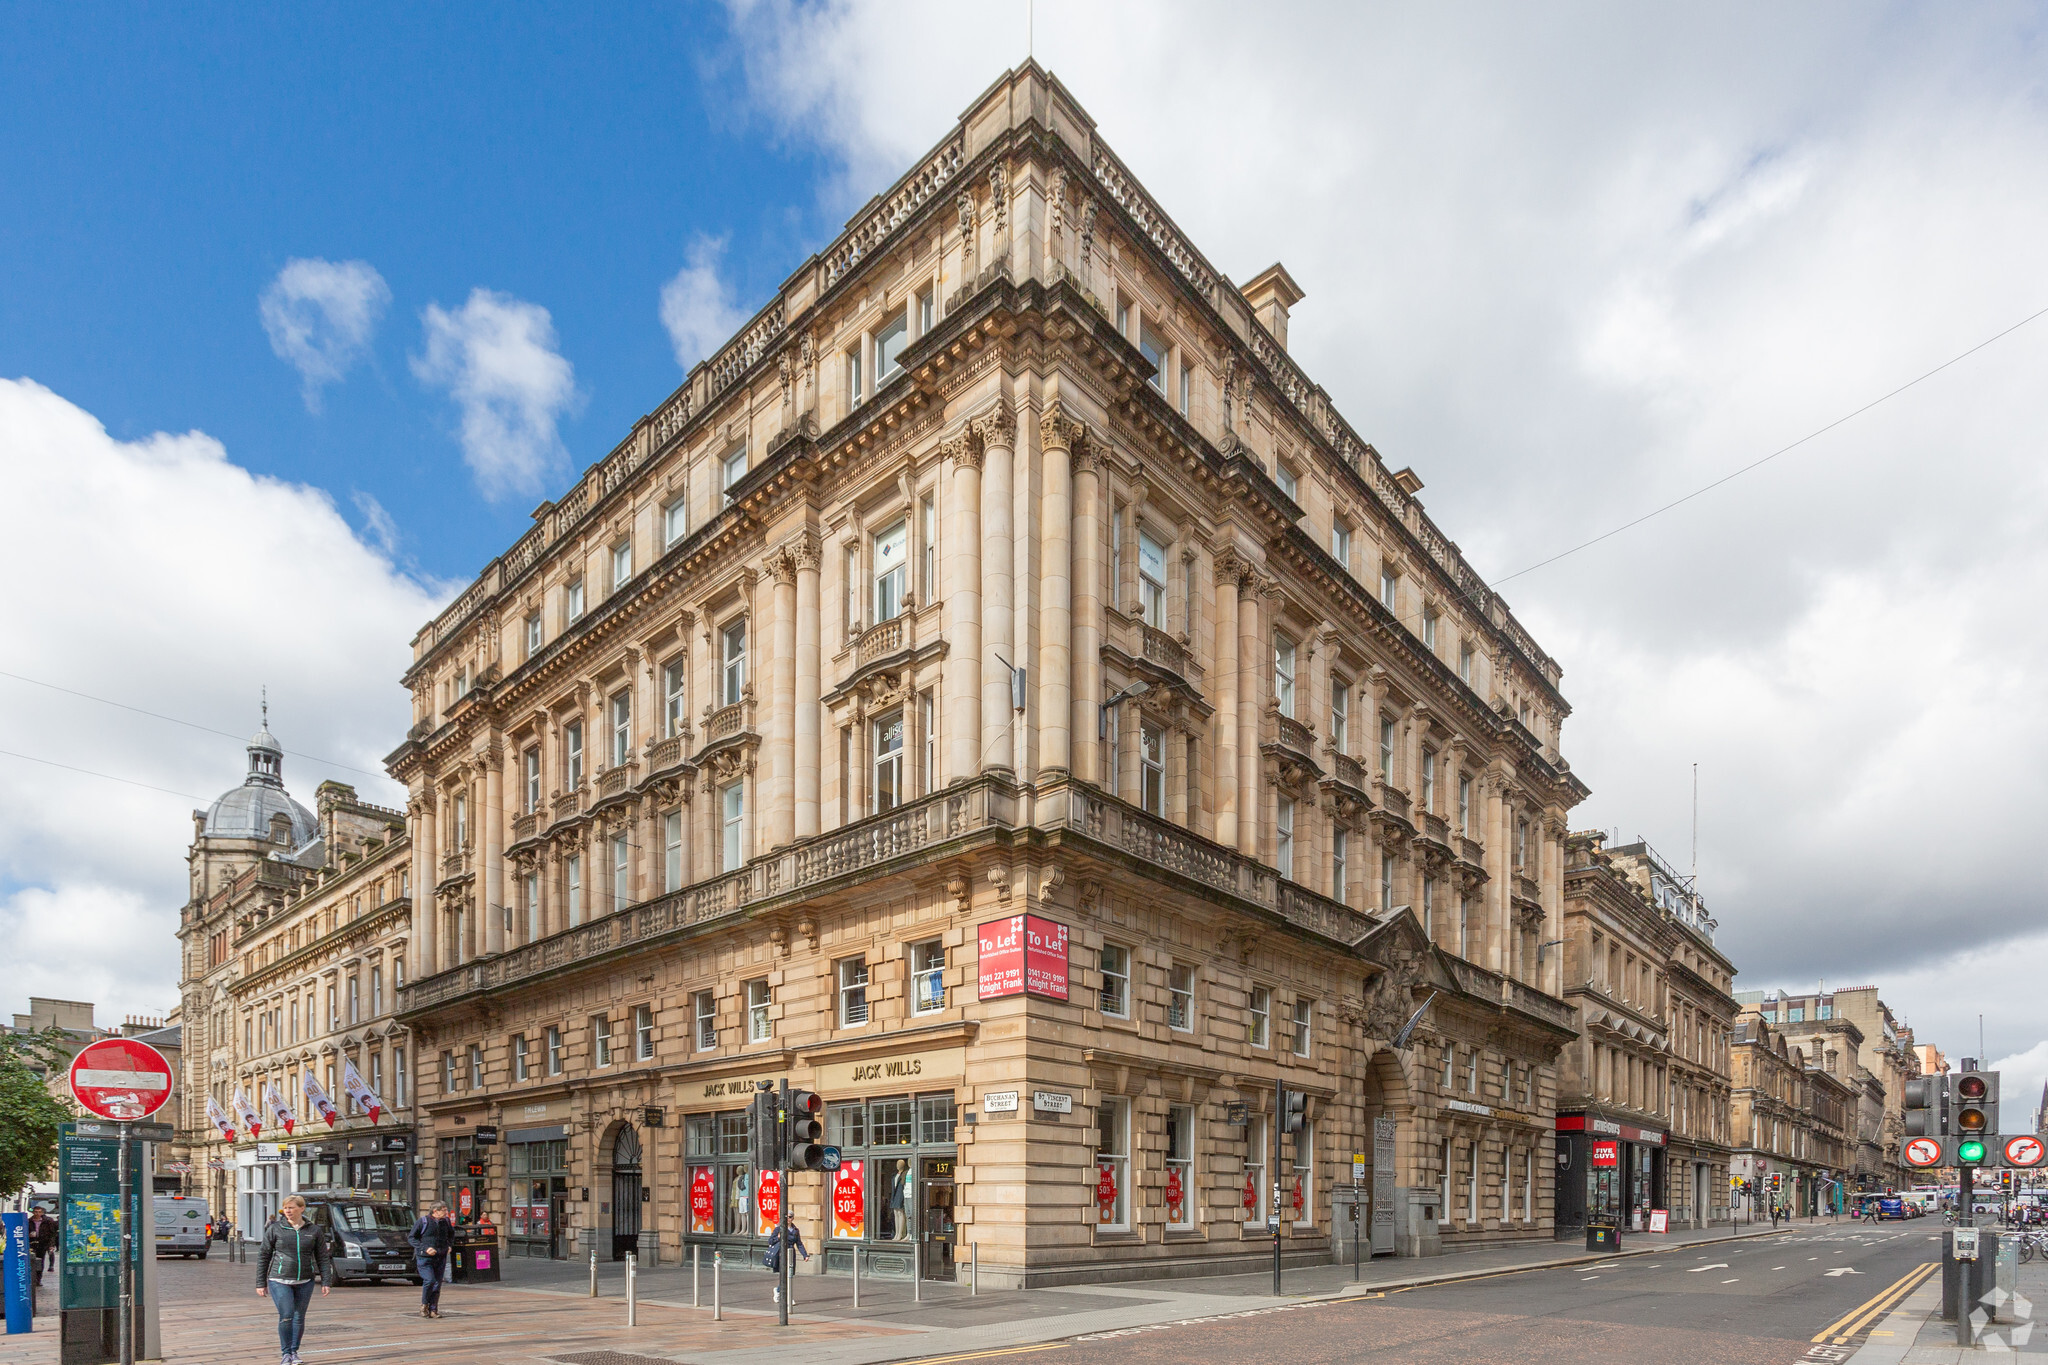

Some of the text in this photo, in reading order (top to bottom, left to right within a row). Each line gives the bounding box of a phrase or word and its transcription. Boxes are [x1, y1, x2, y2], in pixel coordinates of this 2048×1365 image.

[979, 933, 1017, 952] To Let
[1027, 930, 1063, 952] To Let
[979, 968, 1020, 983] 0141 221 9191
[1027, 967, 1065, 983] 0141 221 9191
[979, 977, 1023, 994] Knight Frank
[1027, 976, 1049, 990] Knight
[1049, 982, 1067, 994] Frank
[851, 1059, 921, 1081] JACK WILLS
[306, 1085, 319, 1096] 40
[347, 1078, 362, 1090] 40
[703, 1080, 755, 1098] JACK WILLS
[1043, 1100, 1063, 1108] STREET
[1047, 1093, 1068, 1103] VINCENT
[469, 1166, 482, 1174] T2
[936, 1164, 949, 1173] 137
[838, 1187, 856, 1195] SALE
[1099, 1185, 1110, 1194] 50%
[693, 1198, 708, 1209] 50%
[762, 1199, 777, 1211] 50%
[838, 1200, 856, 1213] 50%
[13, 1225, 24, 1238] life
[17, 1259, 26, 1281] water
